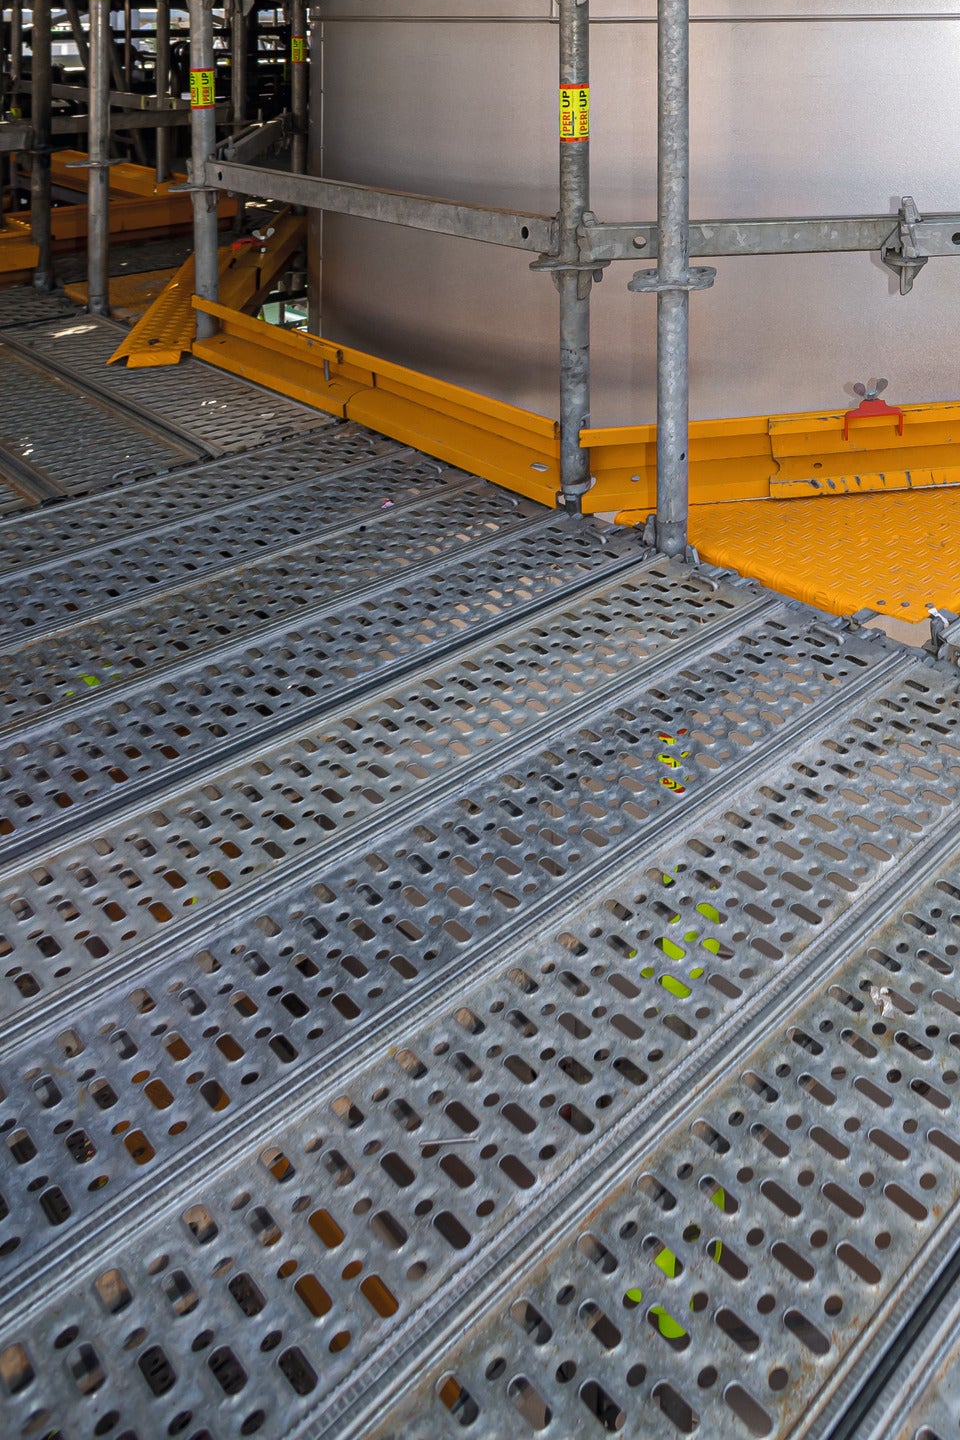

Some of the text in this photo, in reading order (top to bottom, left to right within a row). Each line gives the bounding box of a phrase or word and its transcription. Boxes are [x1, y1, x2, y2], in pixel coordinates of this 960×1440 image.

[201, 72, 210, 104] PERI UP
[562, 90, 571, 133] PERI UP
[579, 90, 588, 133] PERI UP
